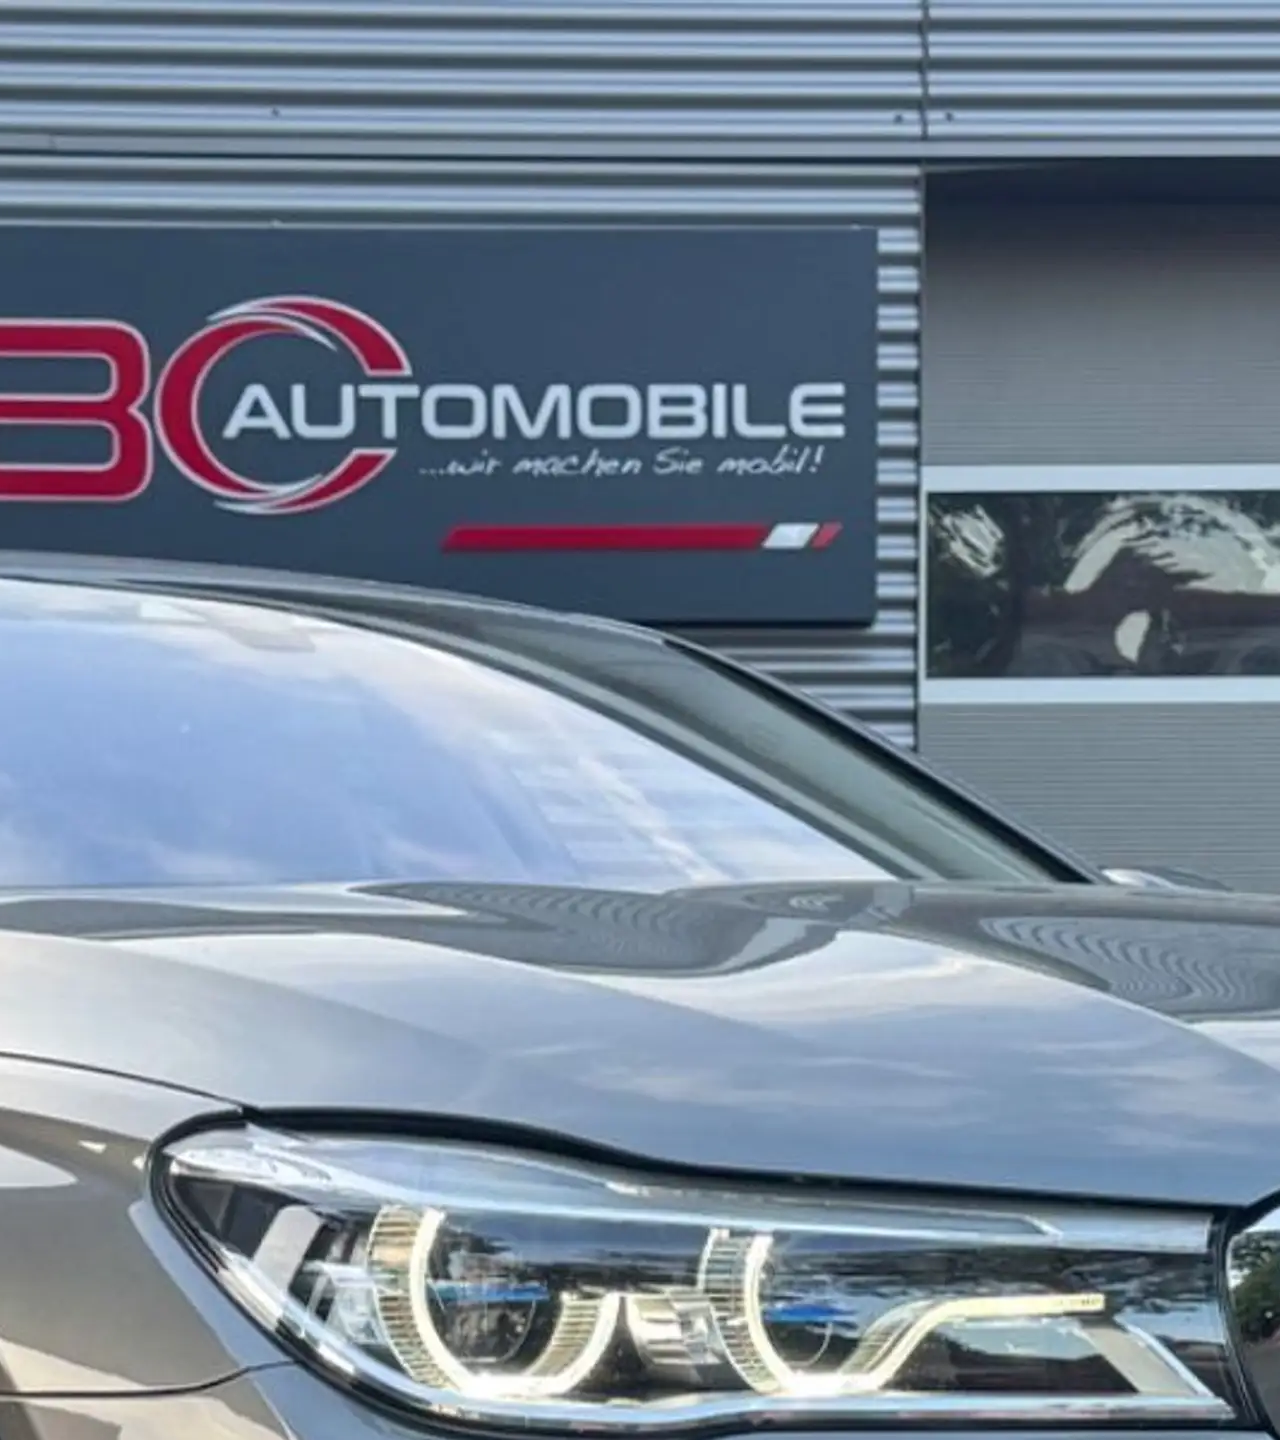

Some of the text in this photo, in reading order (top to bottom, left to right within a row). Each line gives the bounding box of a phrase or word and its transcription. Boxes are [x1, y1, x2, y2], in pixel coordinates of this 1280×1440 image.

[222, 382, 846, 440] AUTOMOBILE
[512, 448, 642, 476] machen
[652, 445, 704, 475] Sie
[717, 444, 825, 476] mobil!
